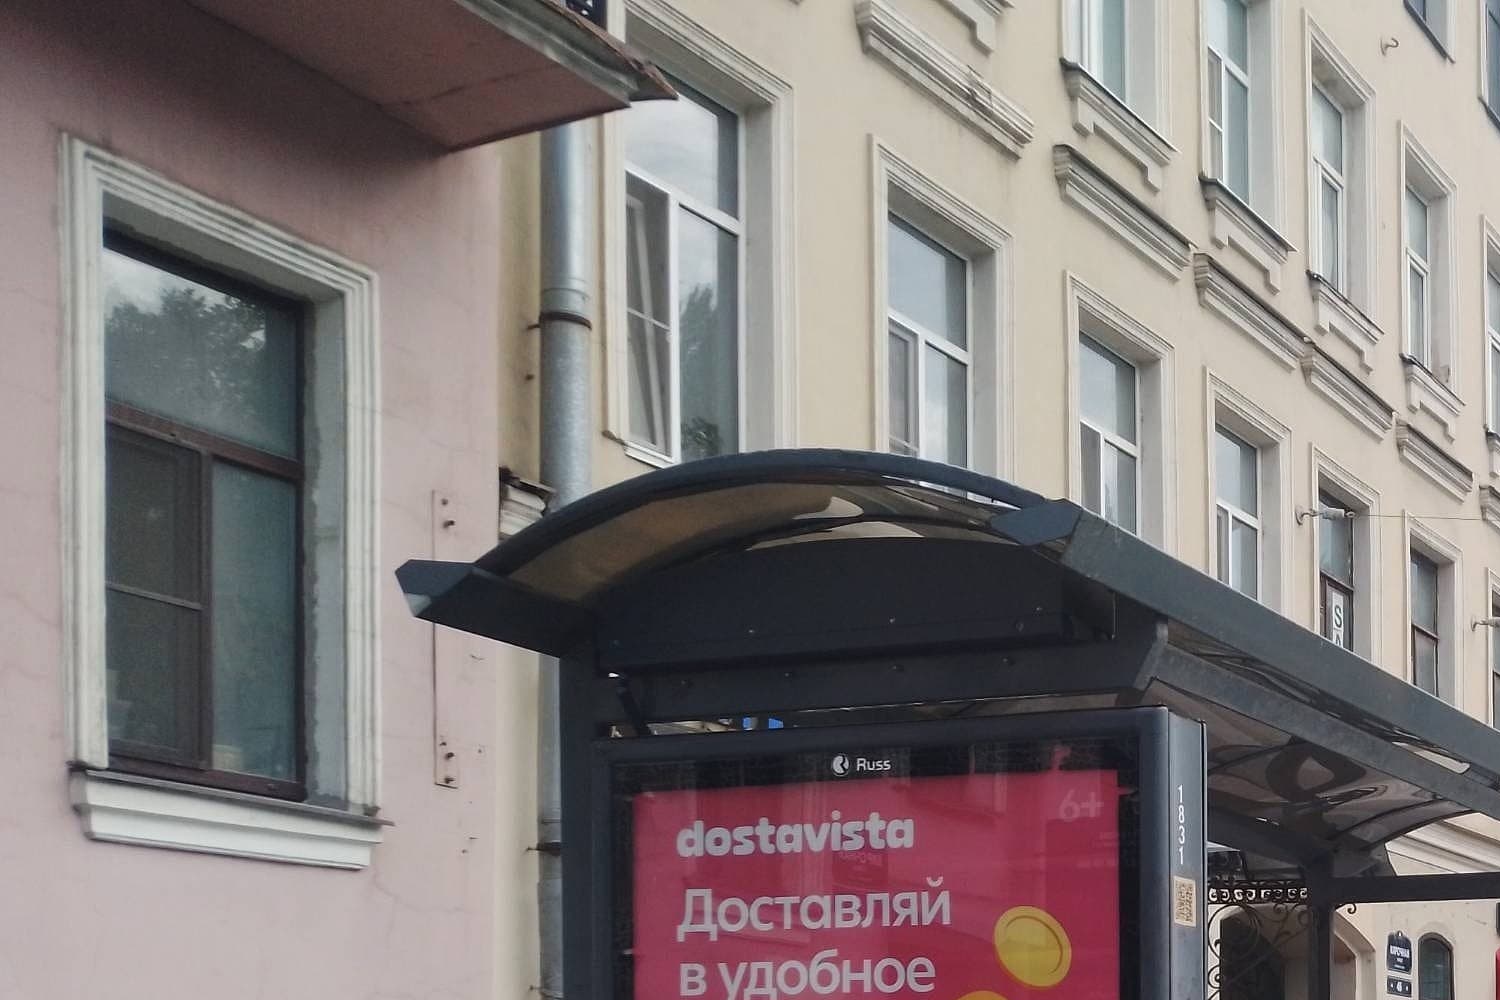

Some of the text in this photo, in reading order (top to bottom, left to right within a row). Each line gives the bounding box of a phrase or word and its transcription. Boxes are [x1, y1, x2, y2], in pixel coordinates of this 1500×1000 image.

[856, 758, 891, 771] Russ
[1059, 789, 1104, 822] 6+
[1177, 784, 1185, 865] 1831
[676, 810, 915, 858] dostavista
[677, 877, 951, 941] Доставляй
[678, 963, 707, 996] в
